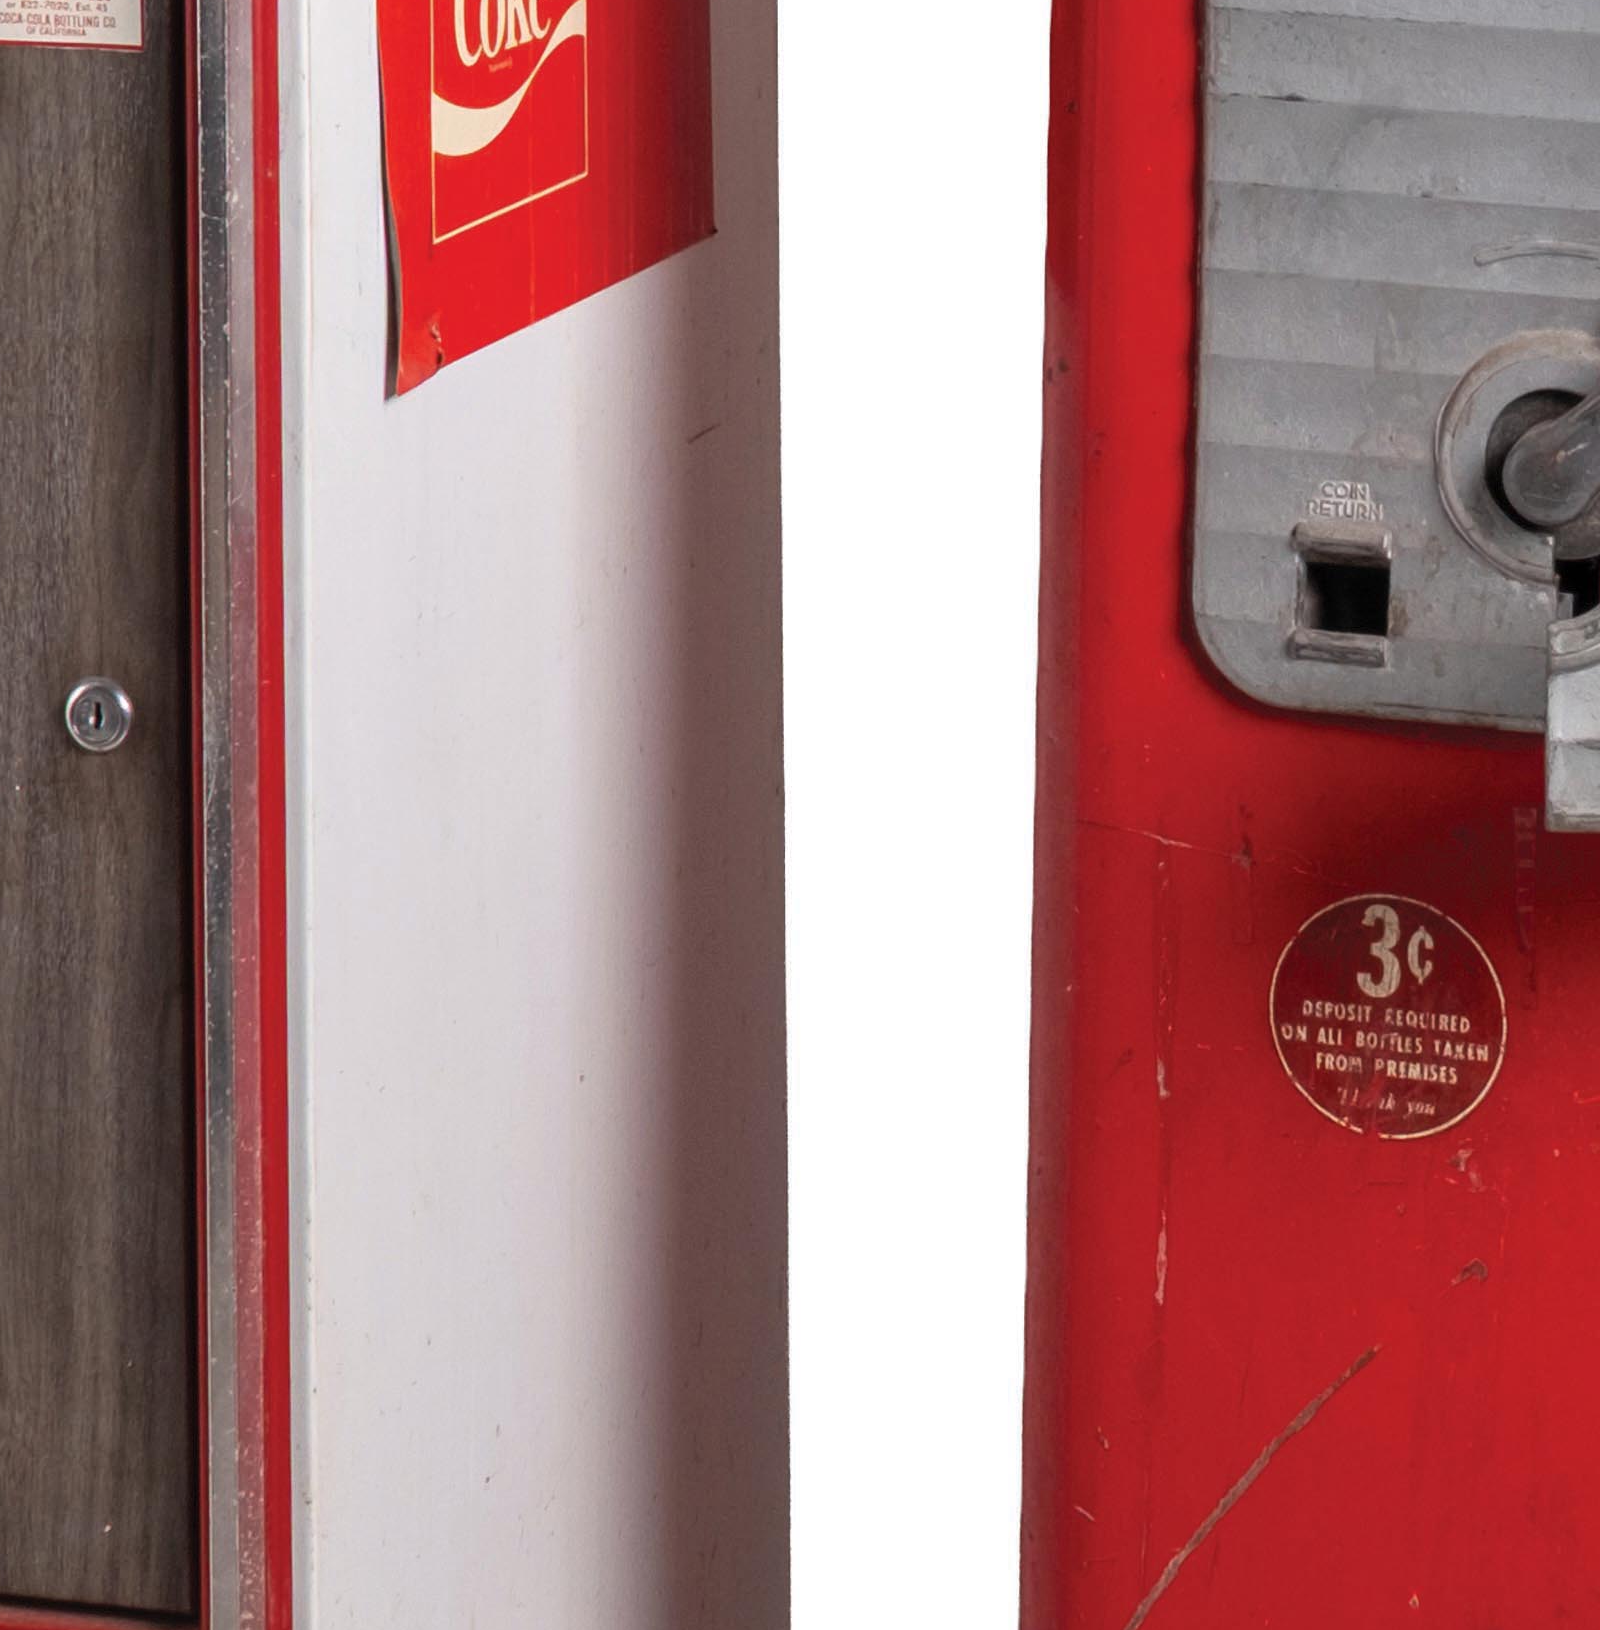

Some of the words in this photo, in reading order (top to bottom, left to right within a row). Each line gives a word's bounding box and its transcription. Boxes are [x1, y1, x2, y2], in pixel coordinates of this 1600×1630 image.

[54, 14, 100, 28] BOTTLING
[1320, 480, 1370, 501] COIN
[1305, 497, 1385, 522] RETURN
[1356, 903, 1435, 999] 3¢
[1302, 999, 1372, 1024] DEPOSIT
[1384, 1007, 1471, 1035] REQUIRED
[1280, 1024, 1308, 1043] ON
[1316, 1026, 1343, 1047] ALL
[1355, 1029, 1424, 1055] BOTTLES
[1433, 1039, 1489, 1062] TAKEN
[1315, 1052, 1363, 1073] FROM
[1374, 1057, 1459, 1086] PREMISES
